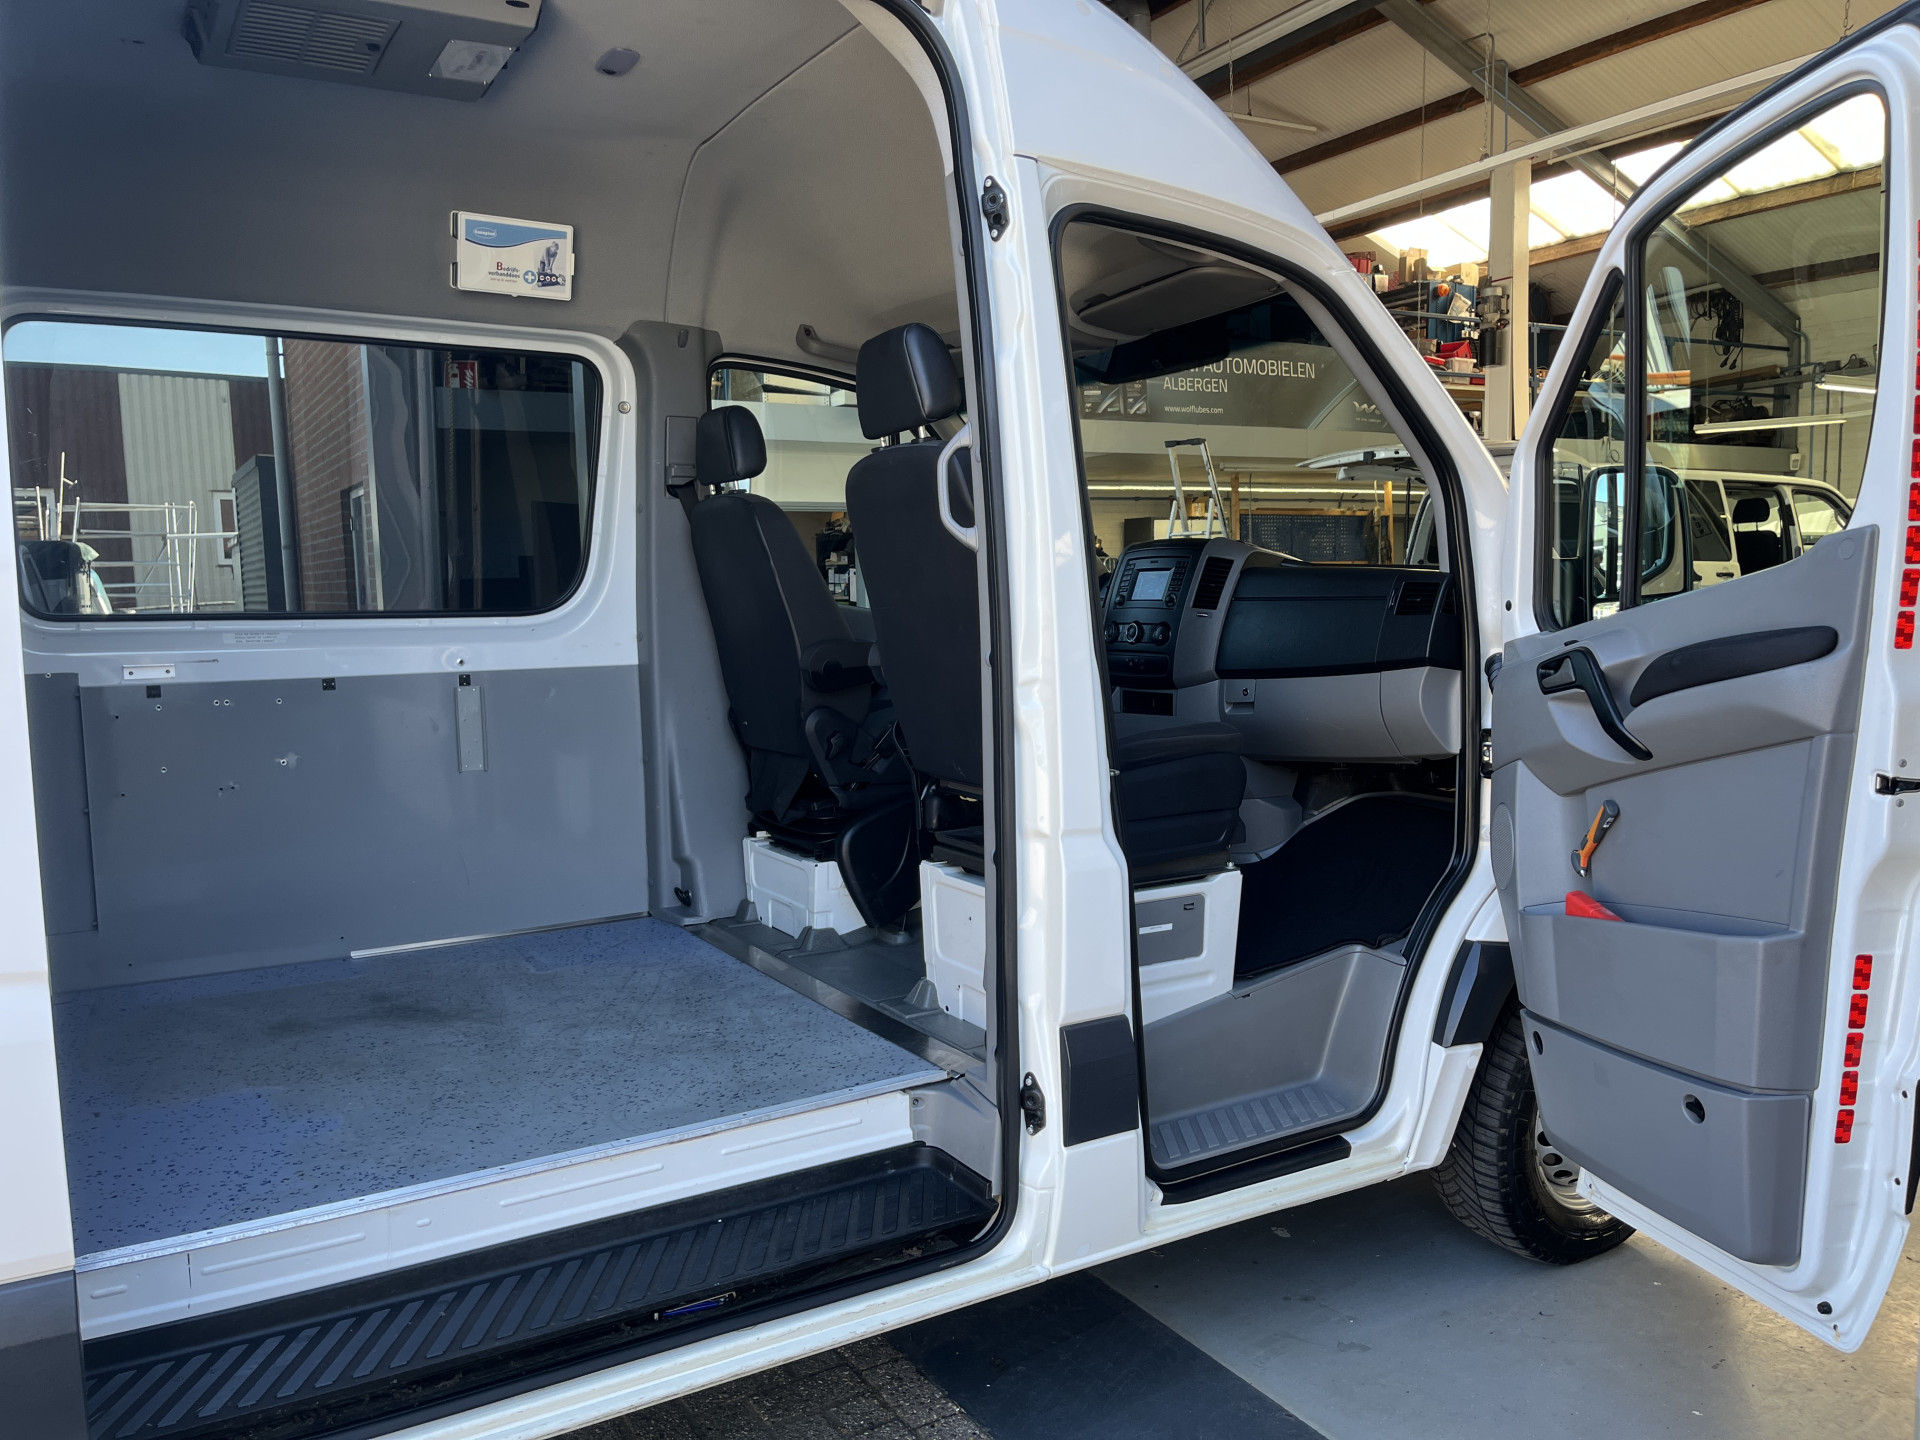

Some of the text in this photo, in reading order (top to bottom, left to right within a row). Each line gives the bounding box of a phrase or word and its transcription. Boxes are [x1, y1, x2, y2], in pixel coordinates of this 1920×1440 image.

[1203, 357, 1315, 379] AUTOMOBIELEN
[1163, 376, 1228, 393] ALBERGEN
[1164, 405, 1224, 414] www.wolflubes.com
